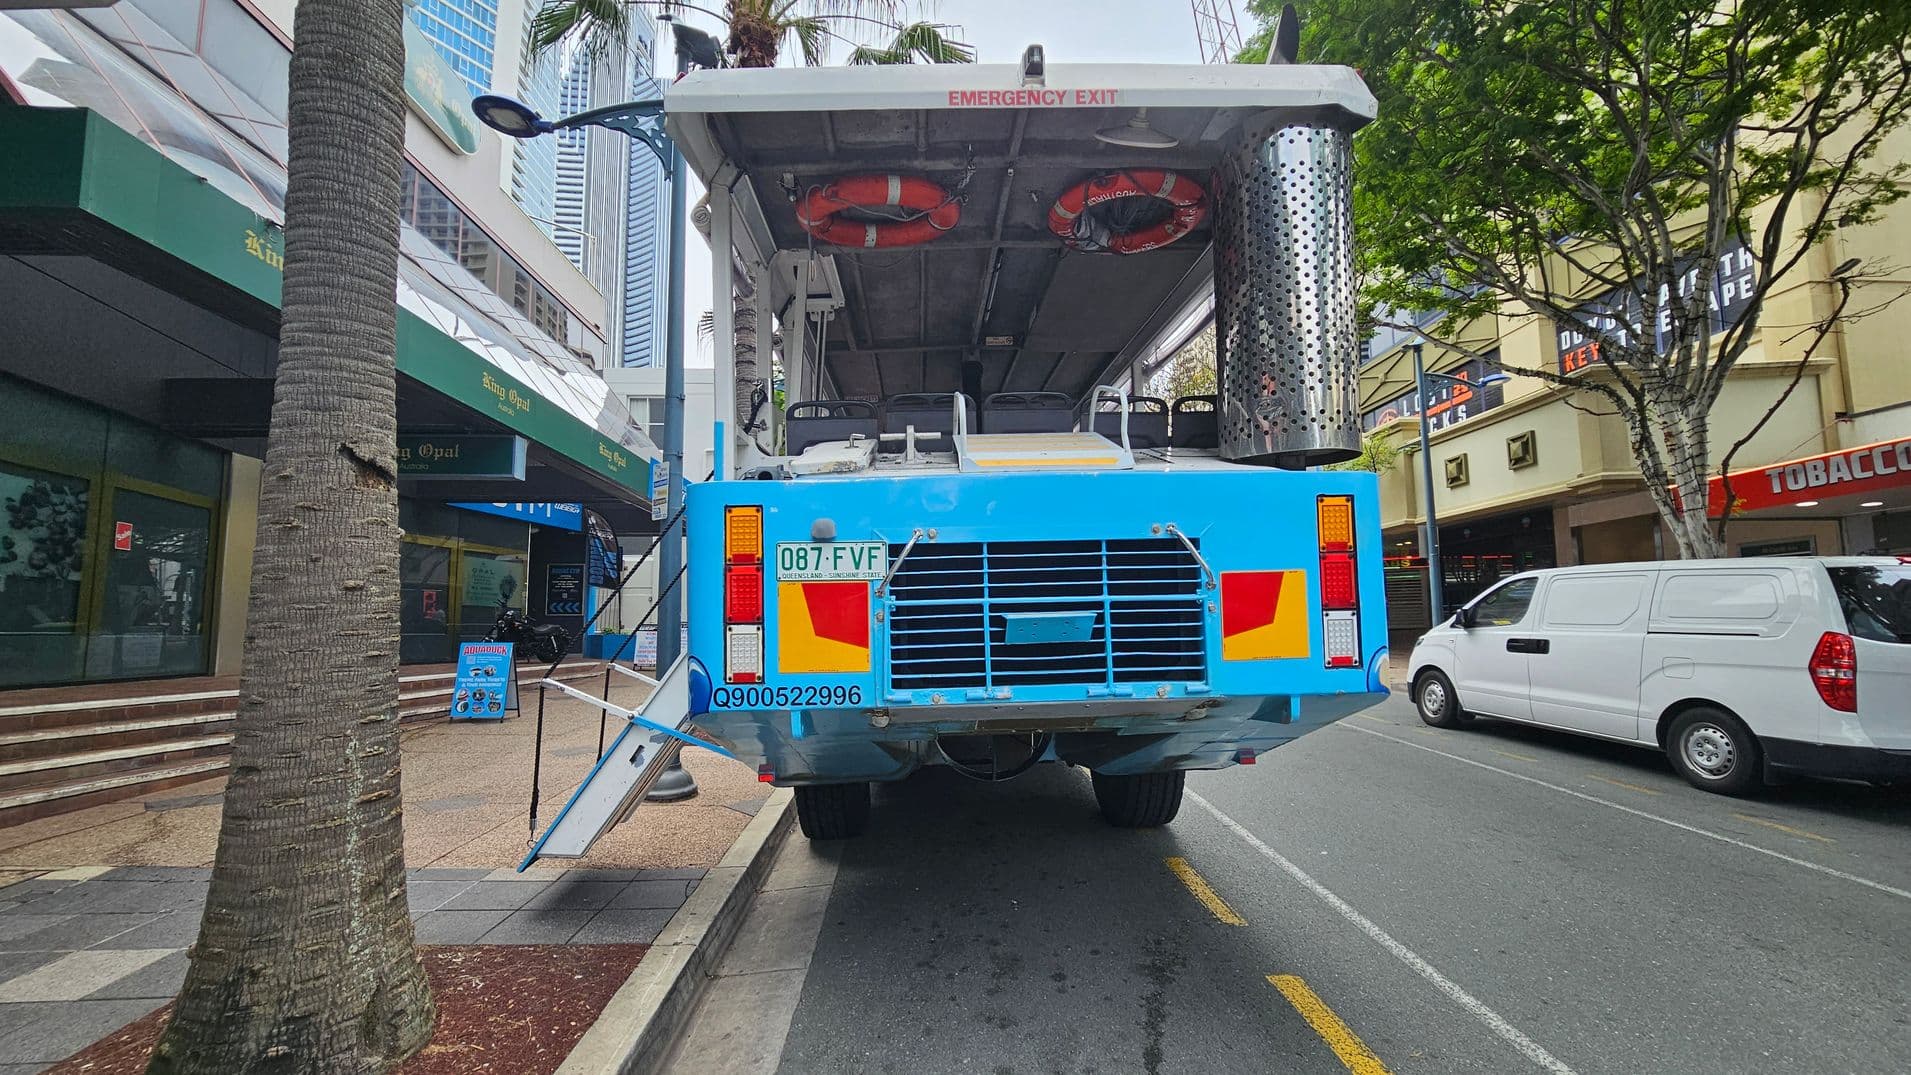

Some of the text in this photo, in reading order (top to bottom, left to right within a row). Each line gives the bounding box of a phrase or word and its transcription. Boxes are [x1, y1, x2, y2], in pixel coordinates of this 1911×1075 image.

[948, 89, 1118, 106] EMERGENCY EXIT
[245, 229, 284, 271] Kin
[1563, 342, 1600, 372] KEY
[482, 371, 530, 412] King Opal
[418, 442, 460, 461] Opal
[783, 571, 822, 579] QUEENSLAND
[829, 571, 860, 579] SUNSHINE
[863, 571, 882, 579] STATE
[713, 685, 862, 709] Q900522996
